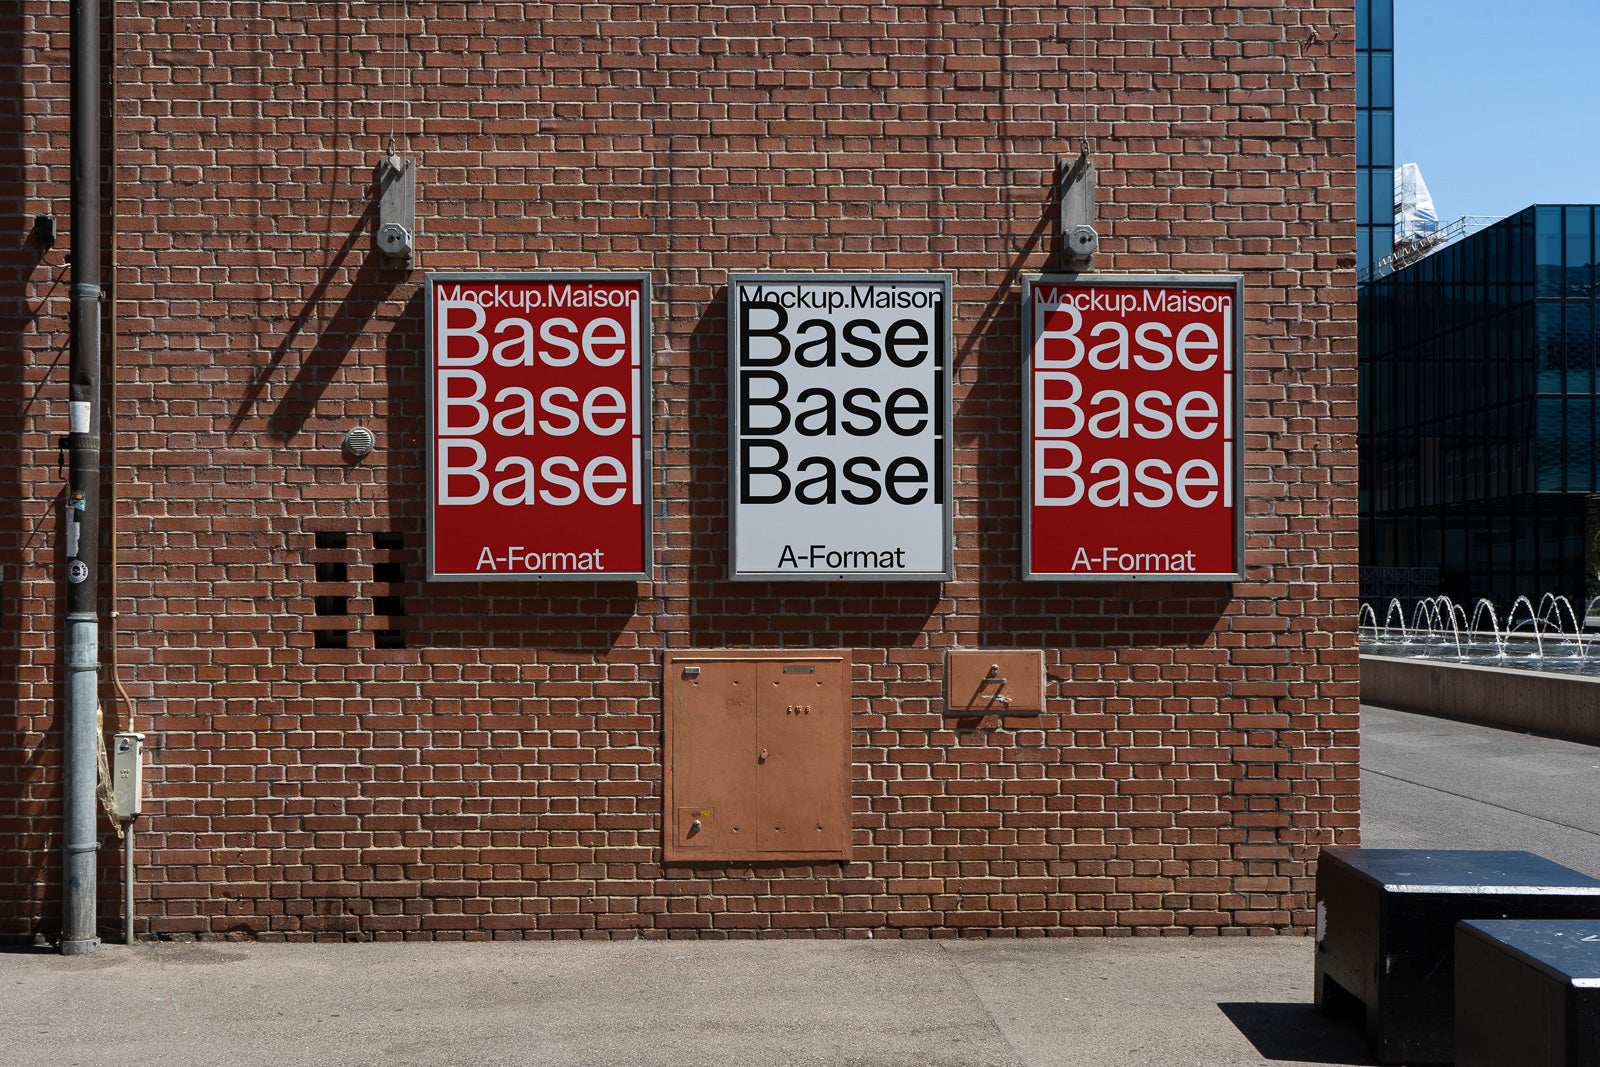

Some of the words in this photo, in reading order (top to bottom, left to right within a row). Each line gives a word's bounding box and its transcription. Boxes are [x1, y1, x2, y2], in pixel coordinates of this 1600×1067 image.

[438, 284, 640, 313] Mockup.Maison
[740, 285, 943, 314] Mockup.Maison
[1035, 287, 1231, 317] Mockup.Maison
[438, 300, 640, 367] Basel
[740, 301, 943, 368] Basel
[1035, 303, 1233, 371] Basel
[438, 369, 641, 436] Basel
[740, 370, 943, 436] Basel
[1035, 371, 1233, 439] Basel
[438, 438, 642, 506] Basel
[740, 438, 943, 505] Basel
[1035, 440, 1233, 508] Basel
[476, 547, 604, 570] A-Format
[778, 545, 905, 568] A-Format
[1071, 547, 1196, 571] A-Format
